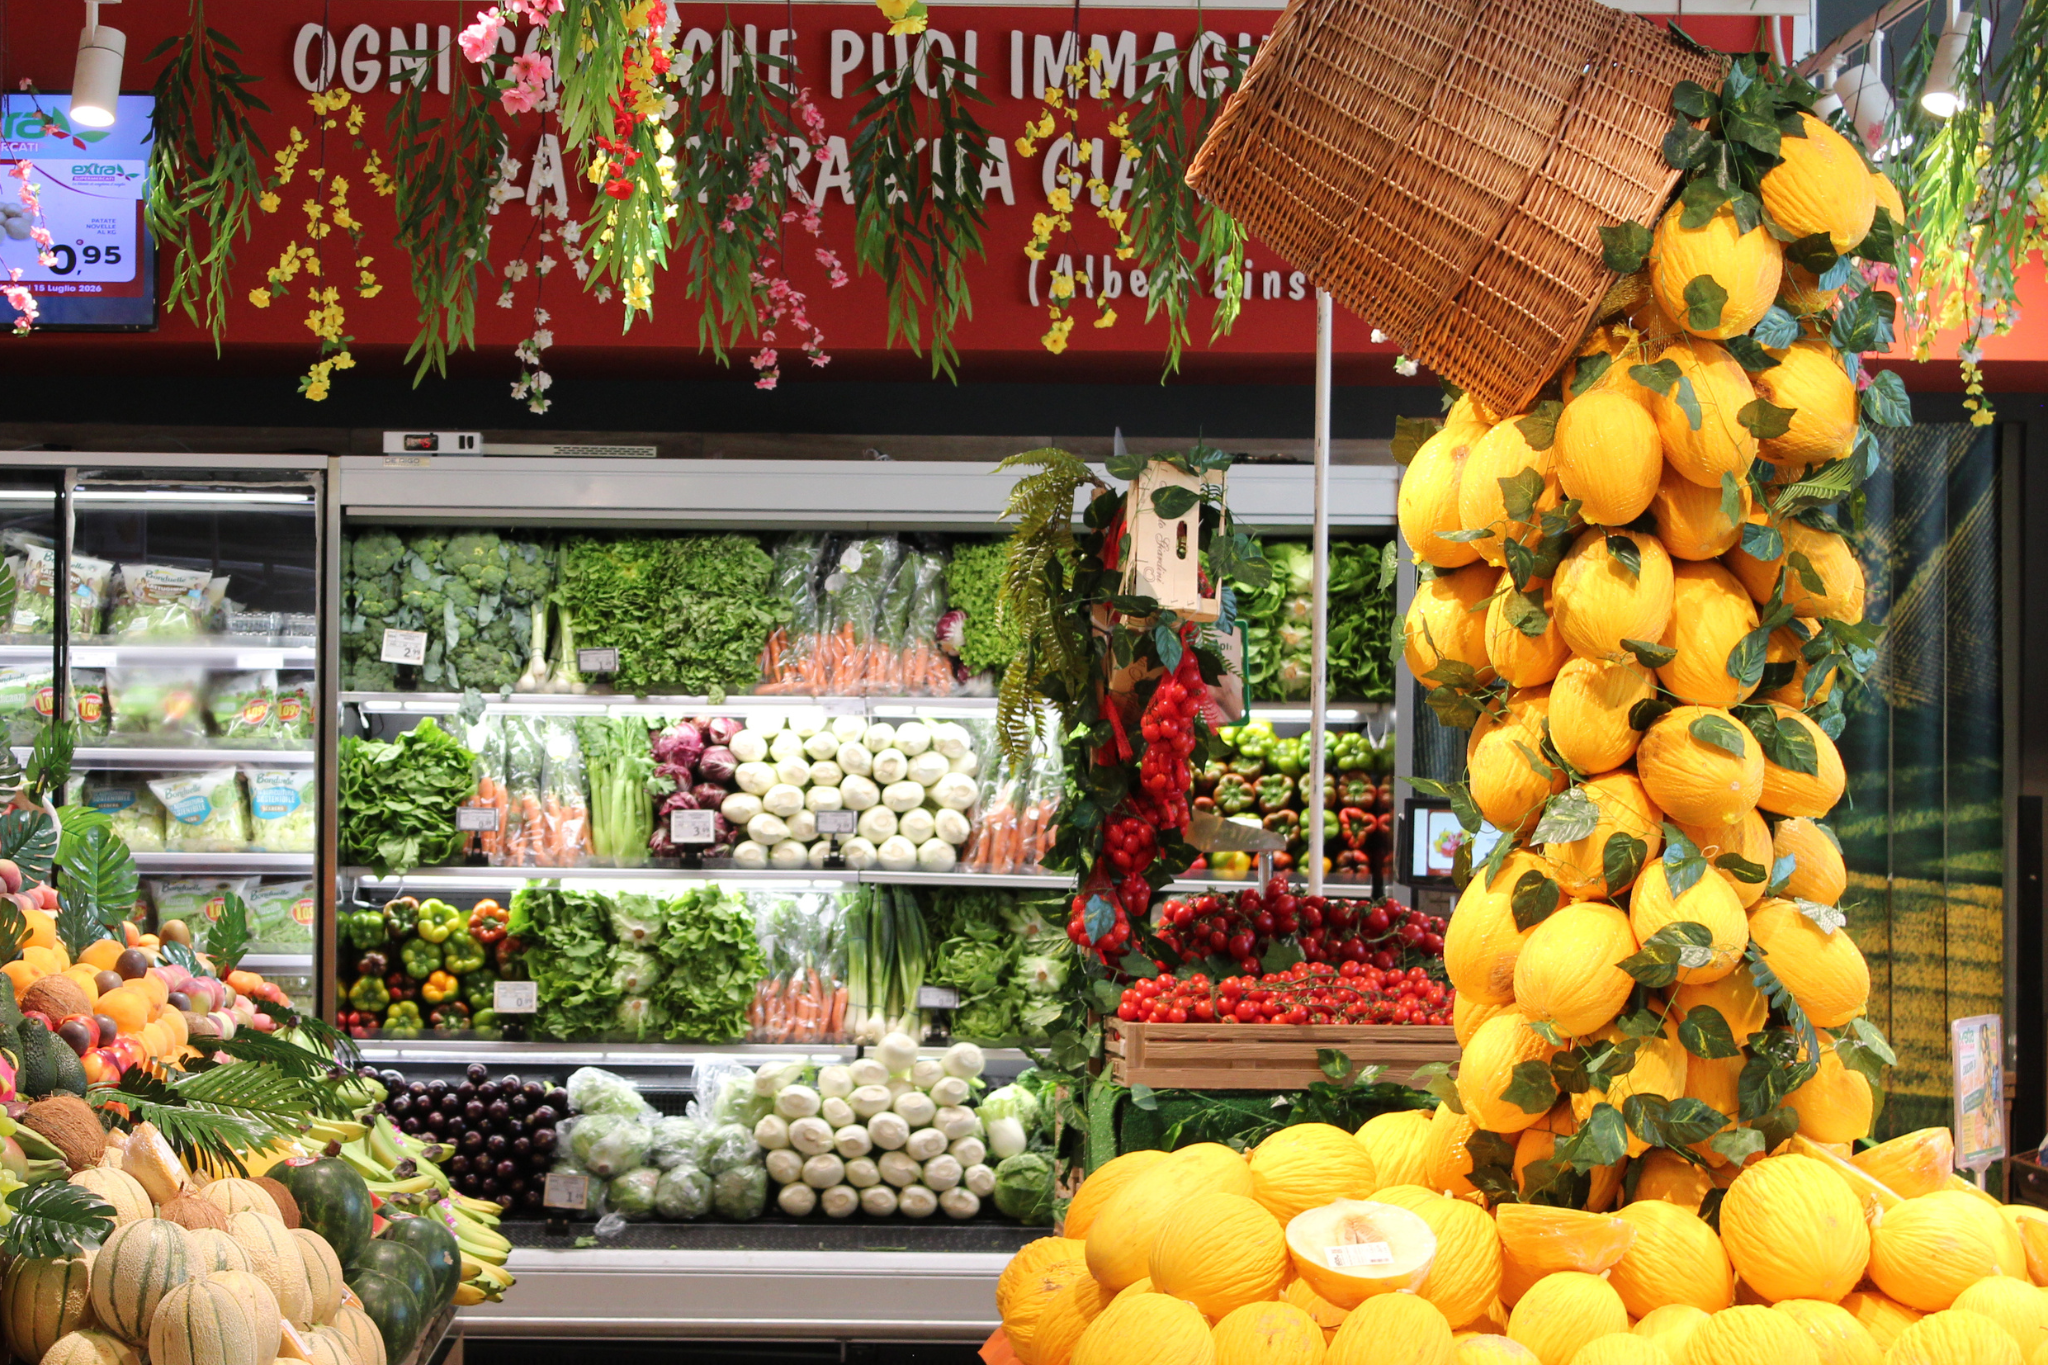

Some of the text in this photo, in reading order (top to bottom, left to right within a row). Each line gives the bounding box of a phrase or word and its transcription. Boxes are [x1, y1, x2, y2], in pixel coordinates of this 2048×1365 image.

[293, 22, 451, 95] OGNI
[679, 23, 799, 98] CHE
[830, 27, 978, 99] PUOI
[71, 163, 116, 176] extra
[34, 284, 45, 292] 15
[47, 284, 77, 293] Luglio
[78, 284, 103, 293] 2026
[145, 569, 187, 583] Bonduelle
[256, 772, 294, 786] Bonduelle
[164, 783, 202, 800] Bonduelle
[161, 882, 203, 892] Bonduelle
[250, 890, 289, 901] Bonduelle
